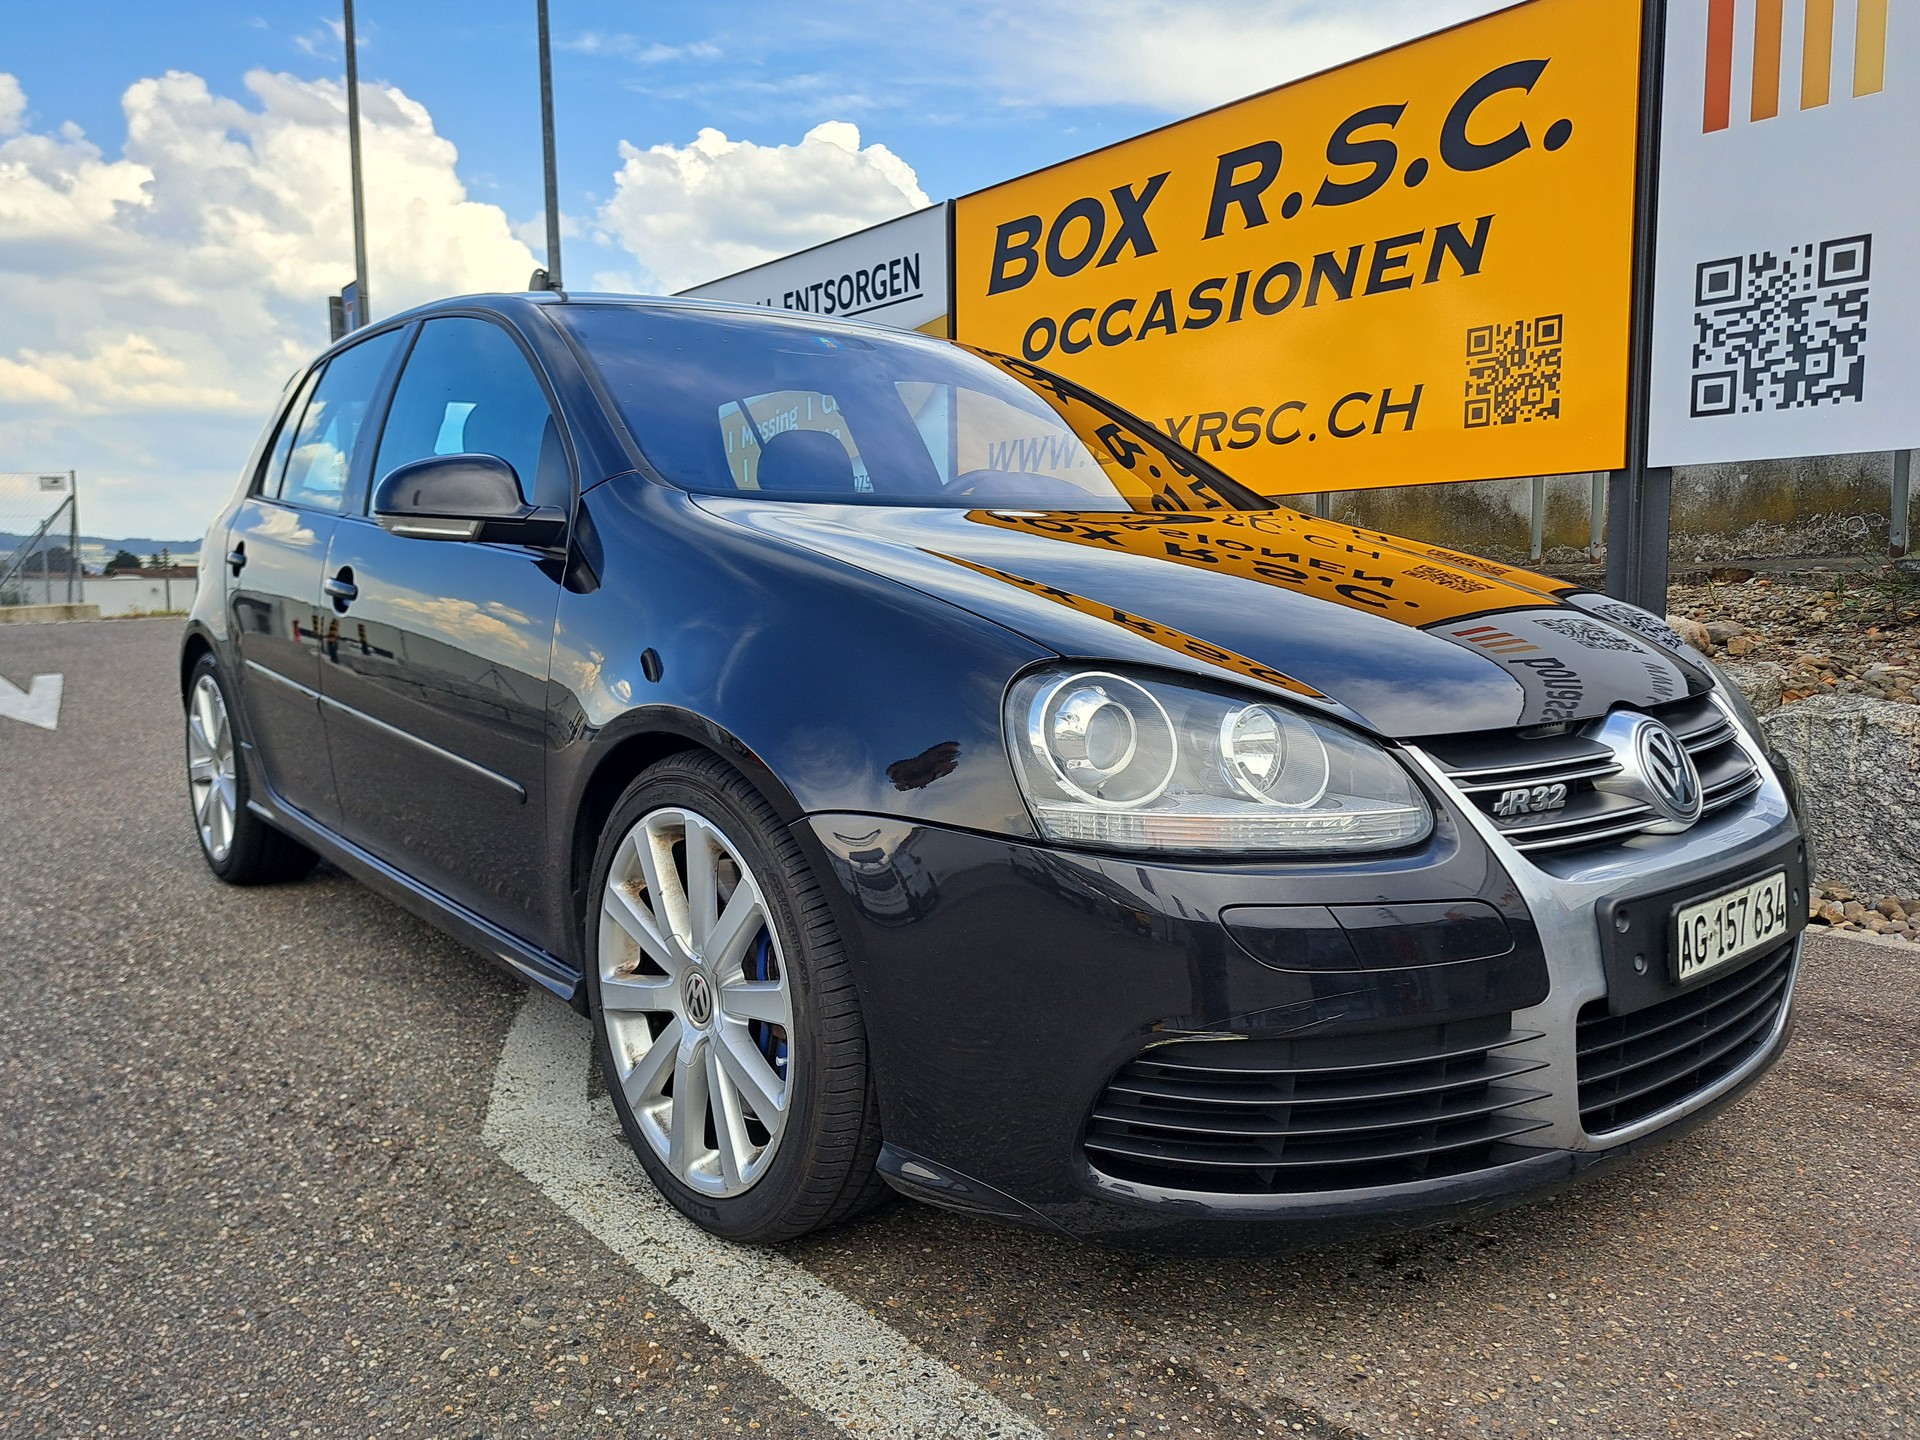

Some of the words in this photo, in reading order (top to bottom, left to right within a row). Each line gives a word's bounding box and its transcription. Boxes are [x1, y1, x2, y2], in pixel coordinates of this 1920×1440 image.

[986, 171, 1172, 296] BOX
[1201, 57, 1572, 240] R.S.C.
[1022, 214, 1496, 362] OCCASIONEN
[1507, 783, 1567, 815] R32
[1754, 881, 1785, 940] 634
